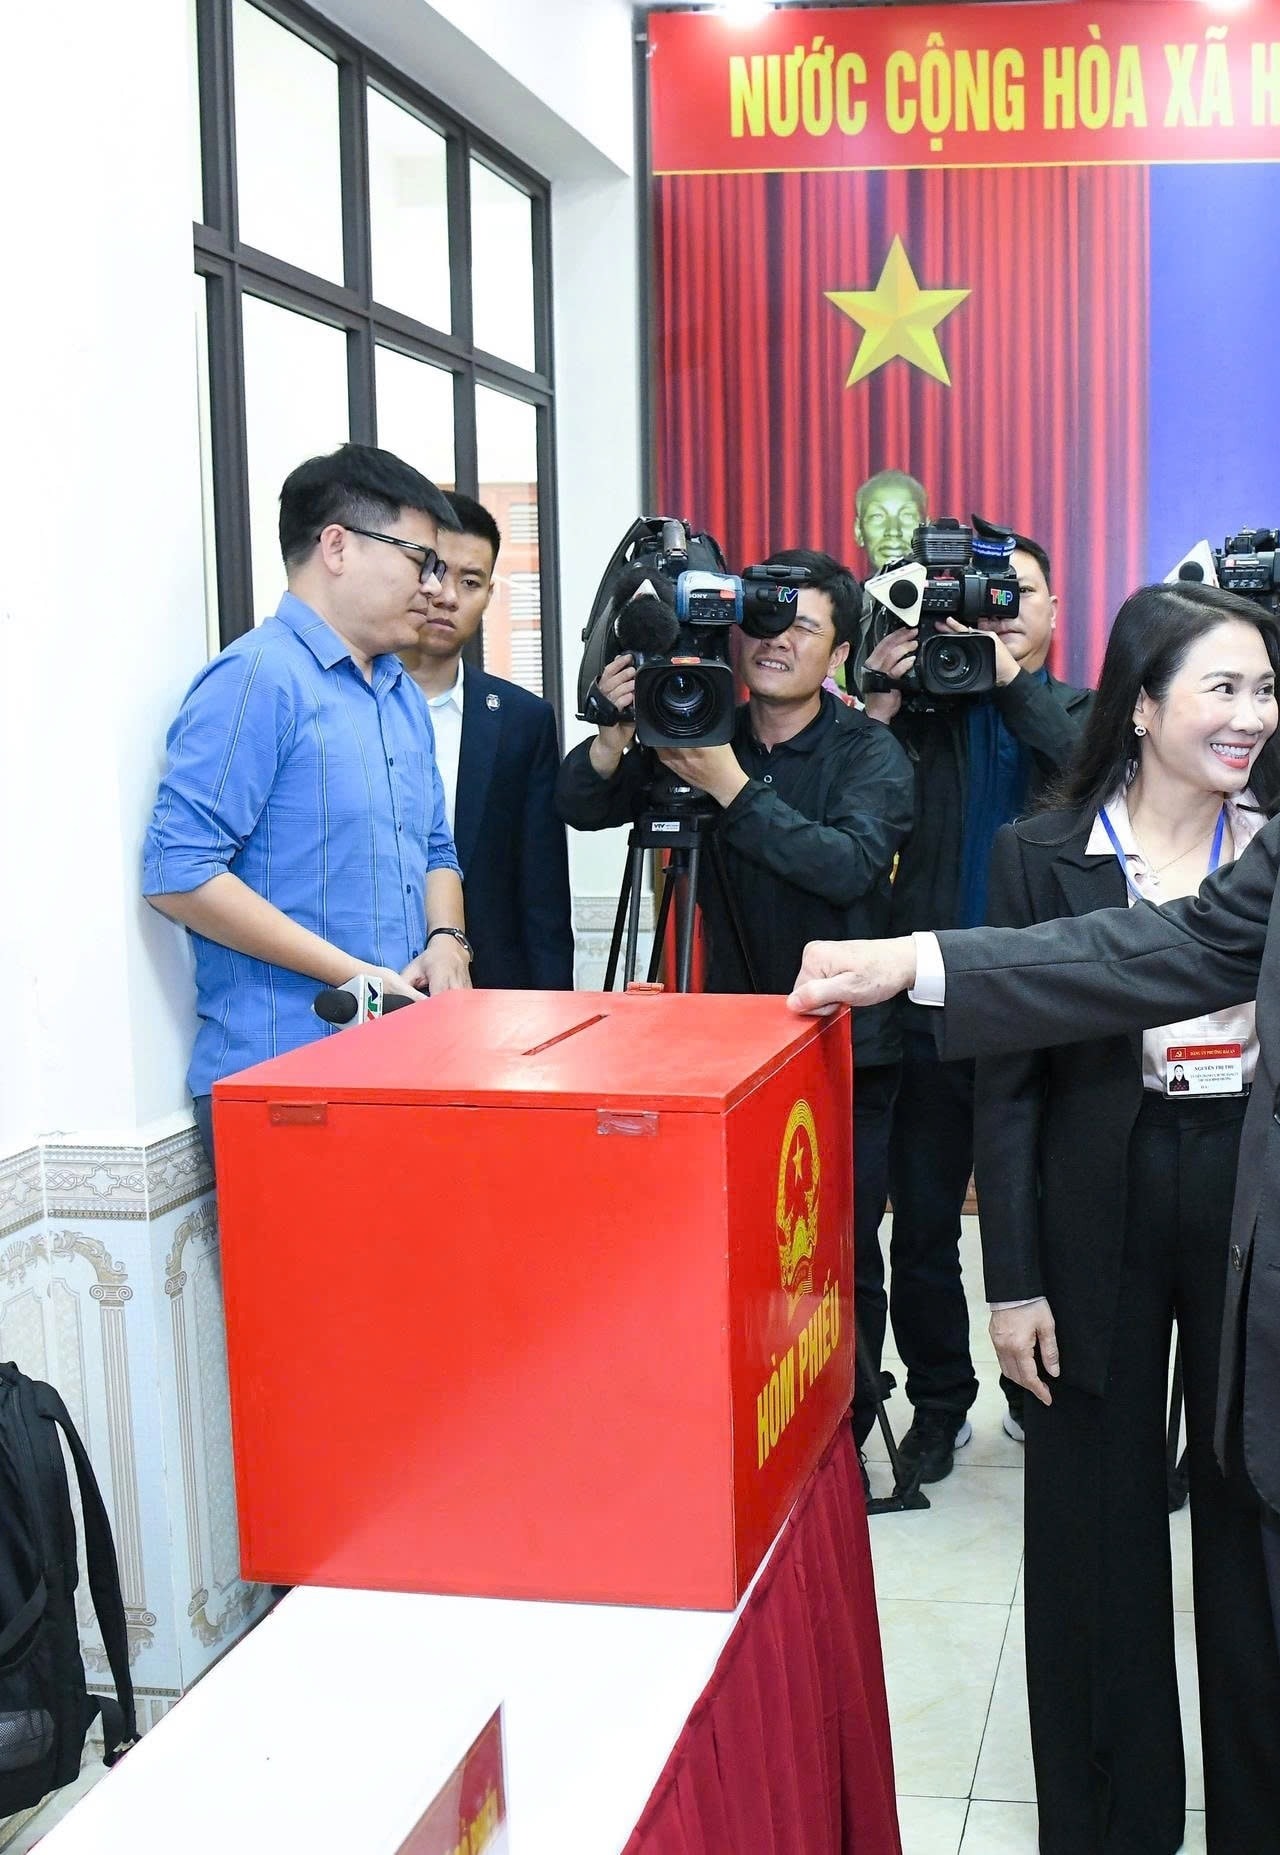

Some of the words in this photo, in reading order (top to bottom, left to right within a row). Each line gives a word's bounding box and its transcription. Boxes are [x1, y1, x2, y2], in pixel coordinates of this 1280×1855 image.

[729, 35, 868, 138] NƯỚC
[885, 31, 1025, 152] CỘNG
[1043, 24, 1148, 131] HÒA
[1164, 25, 1234, 128] XÃ
[991, 588, 1014, 606] THP
[757, 1343, 796, 1471] HÒM
[798, 1268, 841, 1403] PHIẾU
